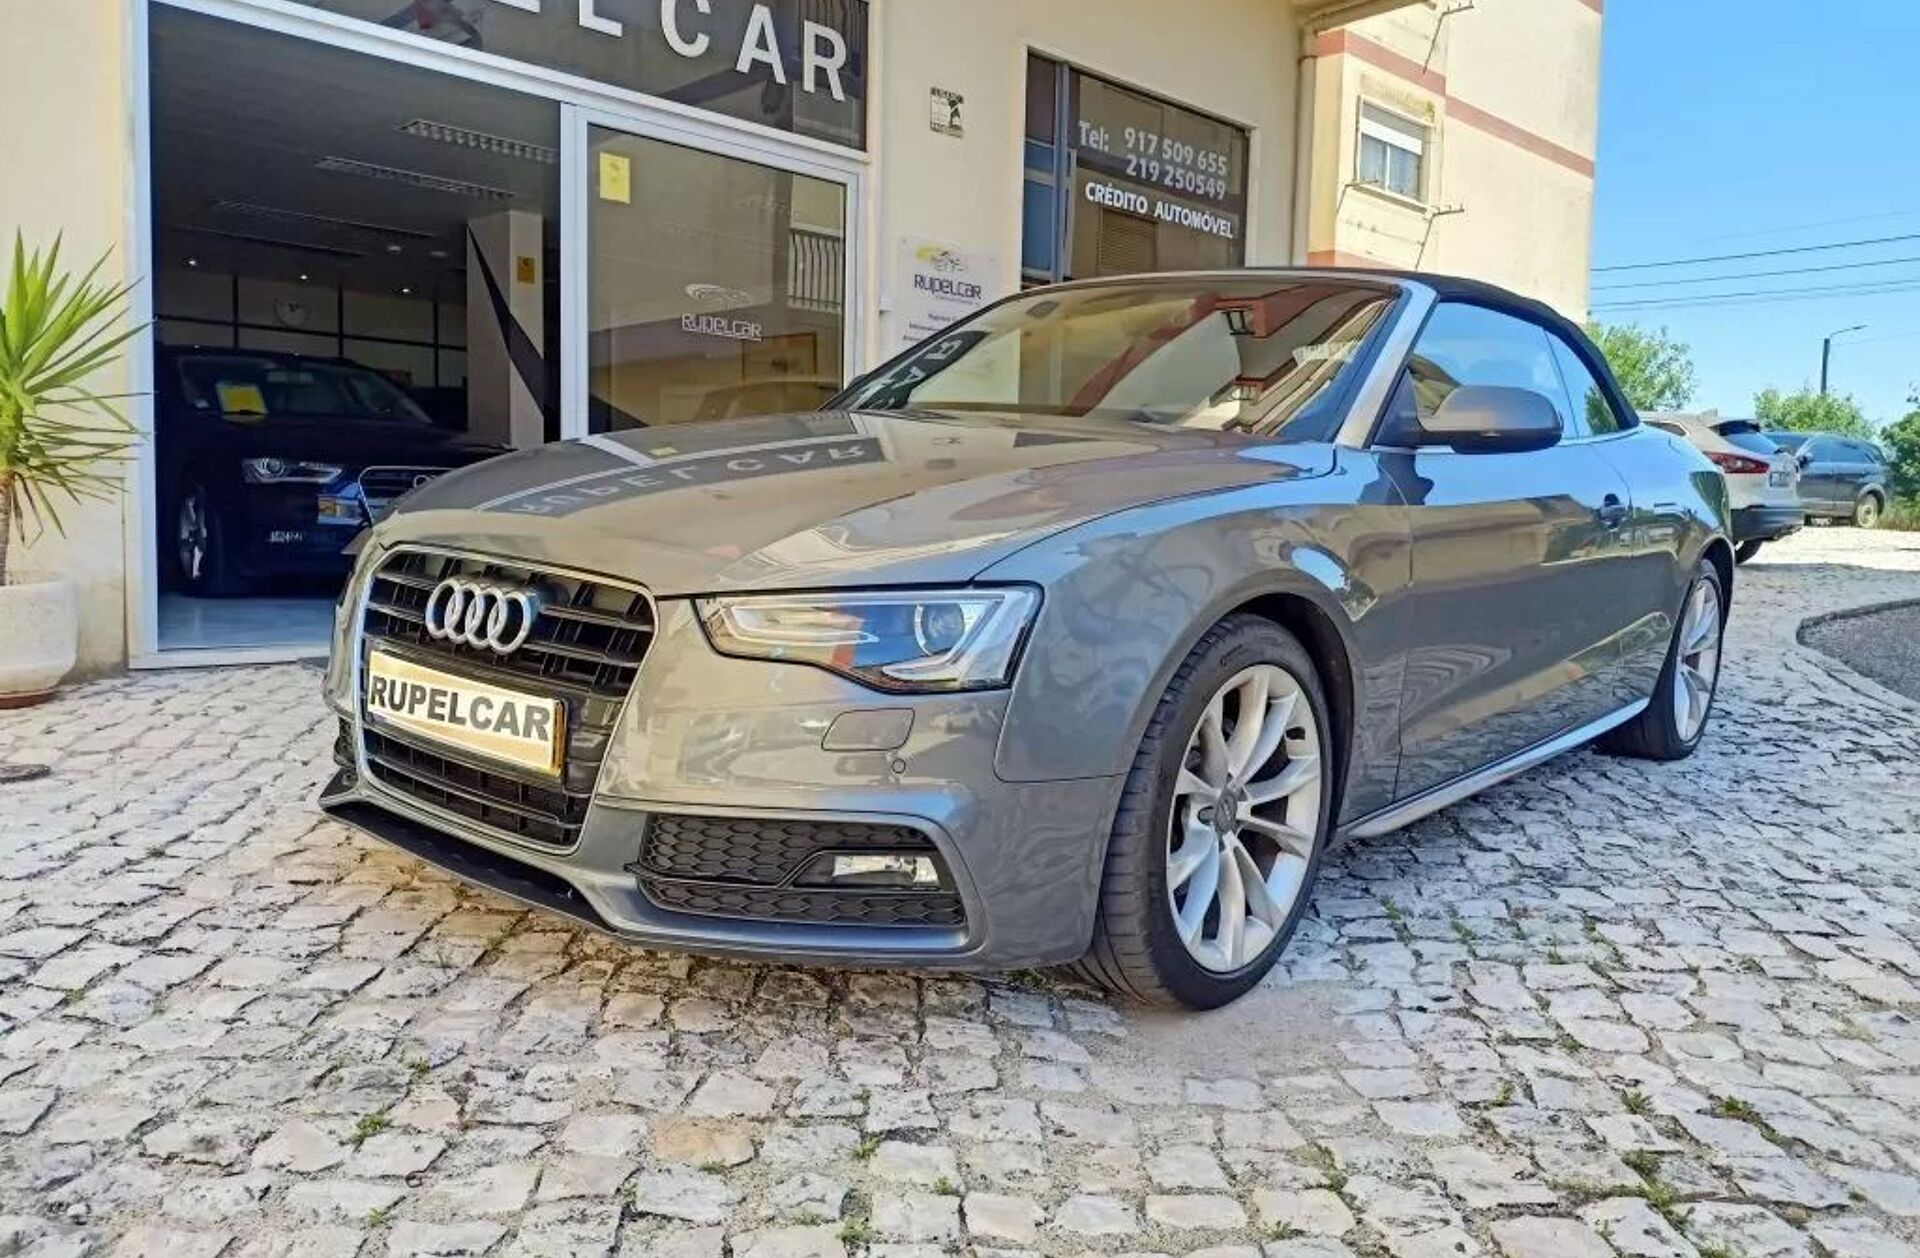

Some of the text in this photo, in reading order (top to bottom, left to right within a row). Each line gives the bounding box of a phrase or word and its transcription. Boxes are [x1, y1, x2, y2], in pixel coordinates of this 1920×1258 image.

[1078, 120, 1228, 176] Tel: 917 509 655
[1126, 154, 1226, 200] 219 250549
[1084, 181, 1234, 239] CRÉDITO AUTOMÓVEL
[369, 675, 550, 742] RUPELCAR
